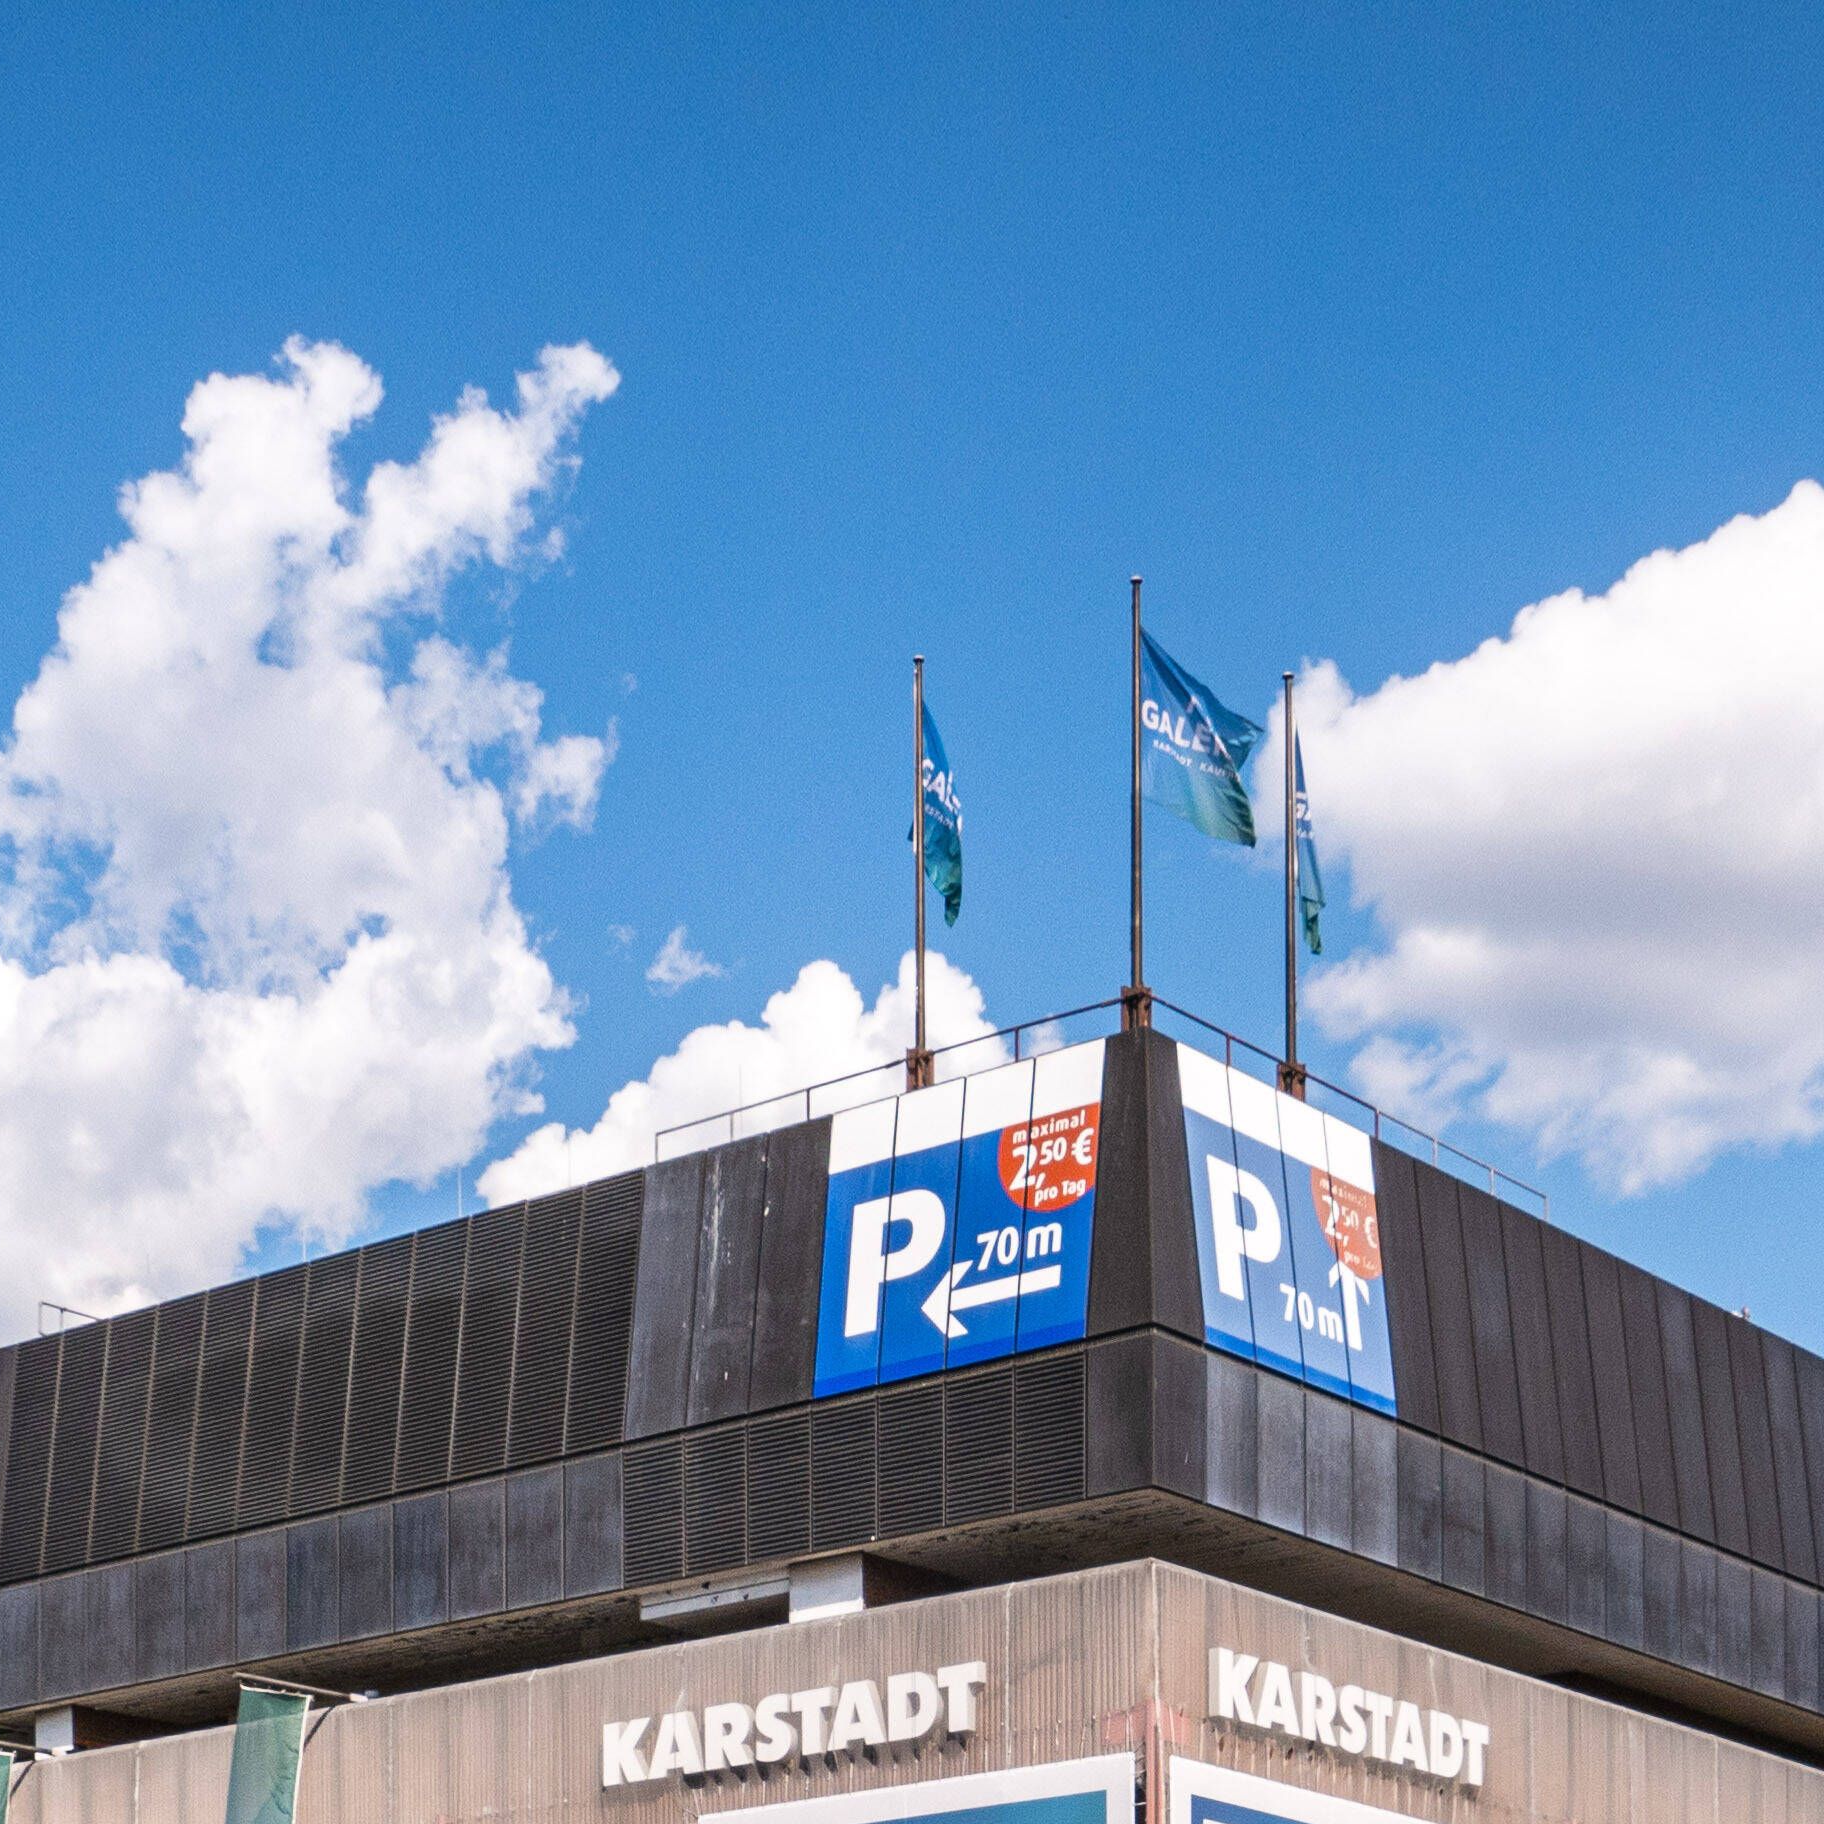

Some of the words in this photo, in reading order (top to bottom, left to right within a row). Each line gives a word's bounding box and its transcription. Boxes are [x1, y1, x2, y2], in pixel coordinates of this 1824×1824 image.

[1012, 1109, 1086, 1144] maximal
[1034, 1185, 1059, 1207] pro
[1061, 1178, 1087, 1198] Tag
[1206, 1153, 1281, 1301] P
[844, 1188, 946, 1338] P
[977, 1225, 1019, 1272] 70
[1025, 1221, 1063, 1259] m
[1279, 1283, 1315, 1331] 70
[1317, 1306, 1345, 1344] m
[601, 1660, 987, 1788] KARSTADT
[1212, 1647, 1490, 1786] KARSTADT
